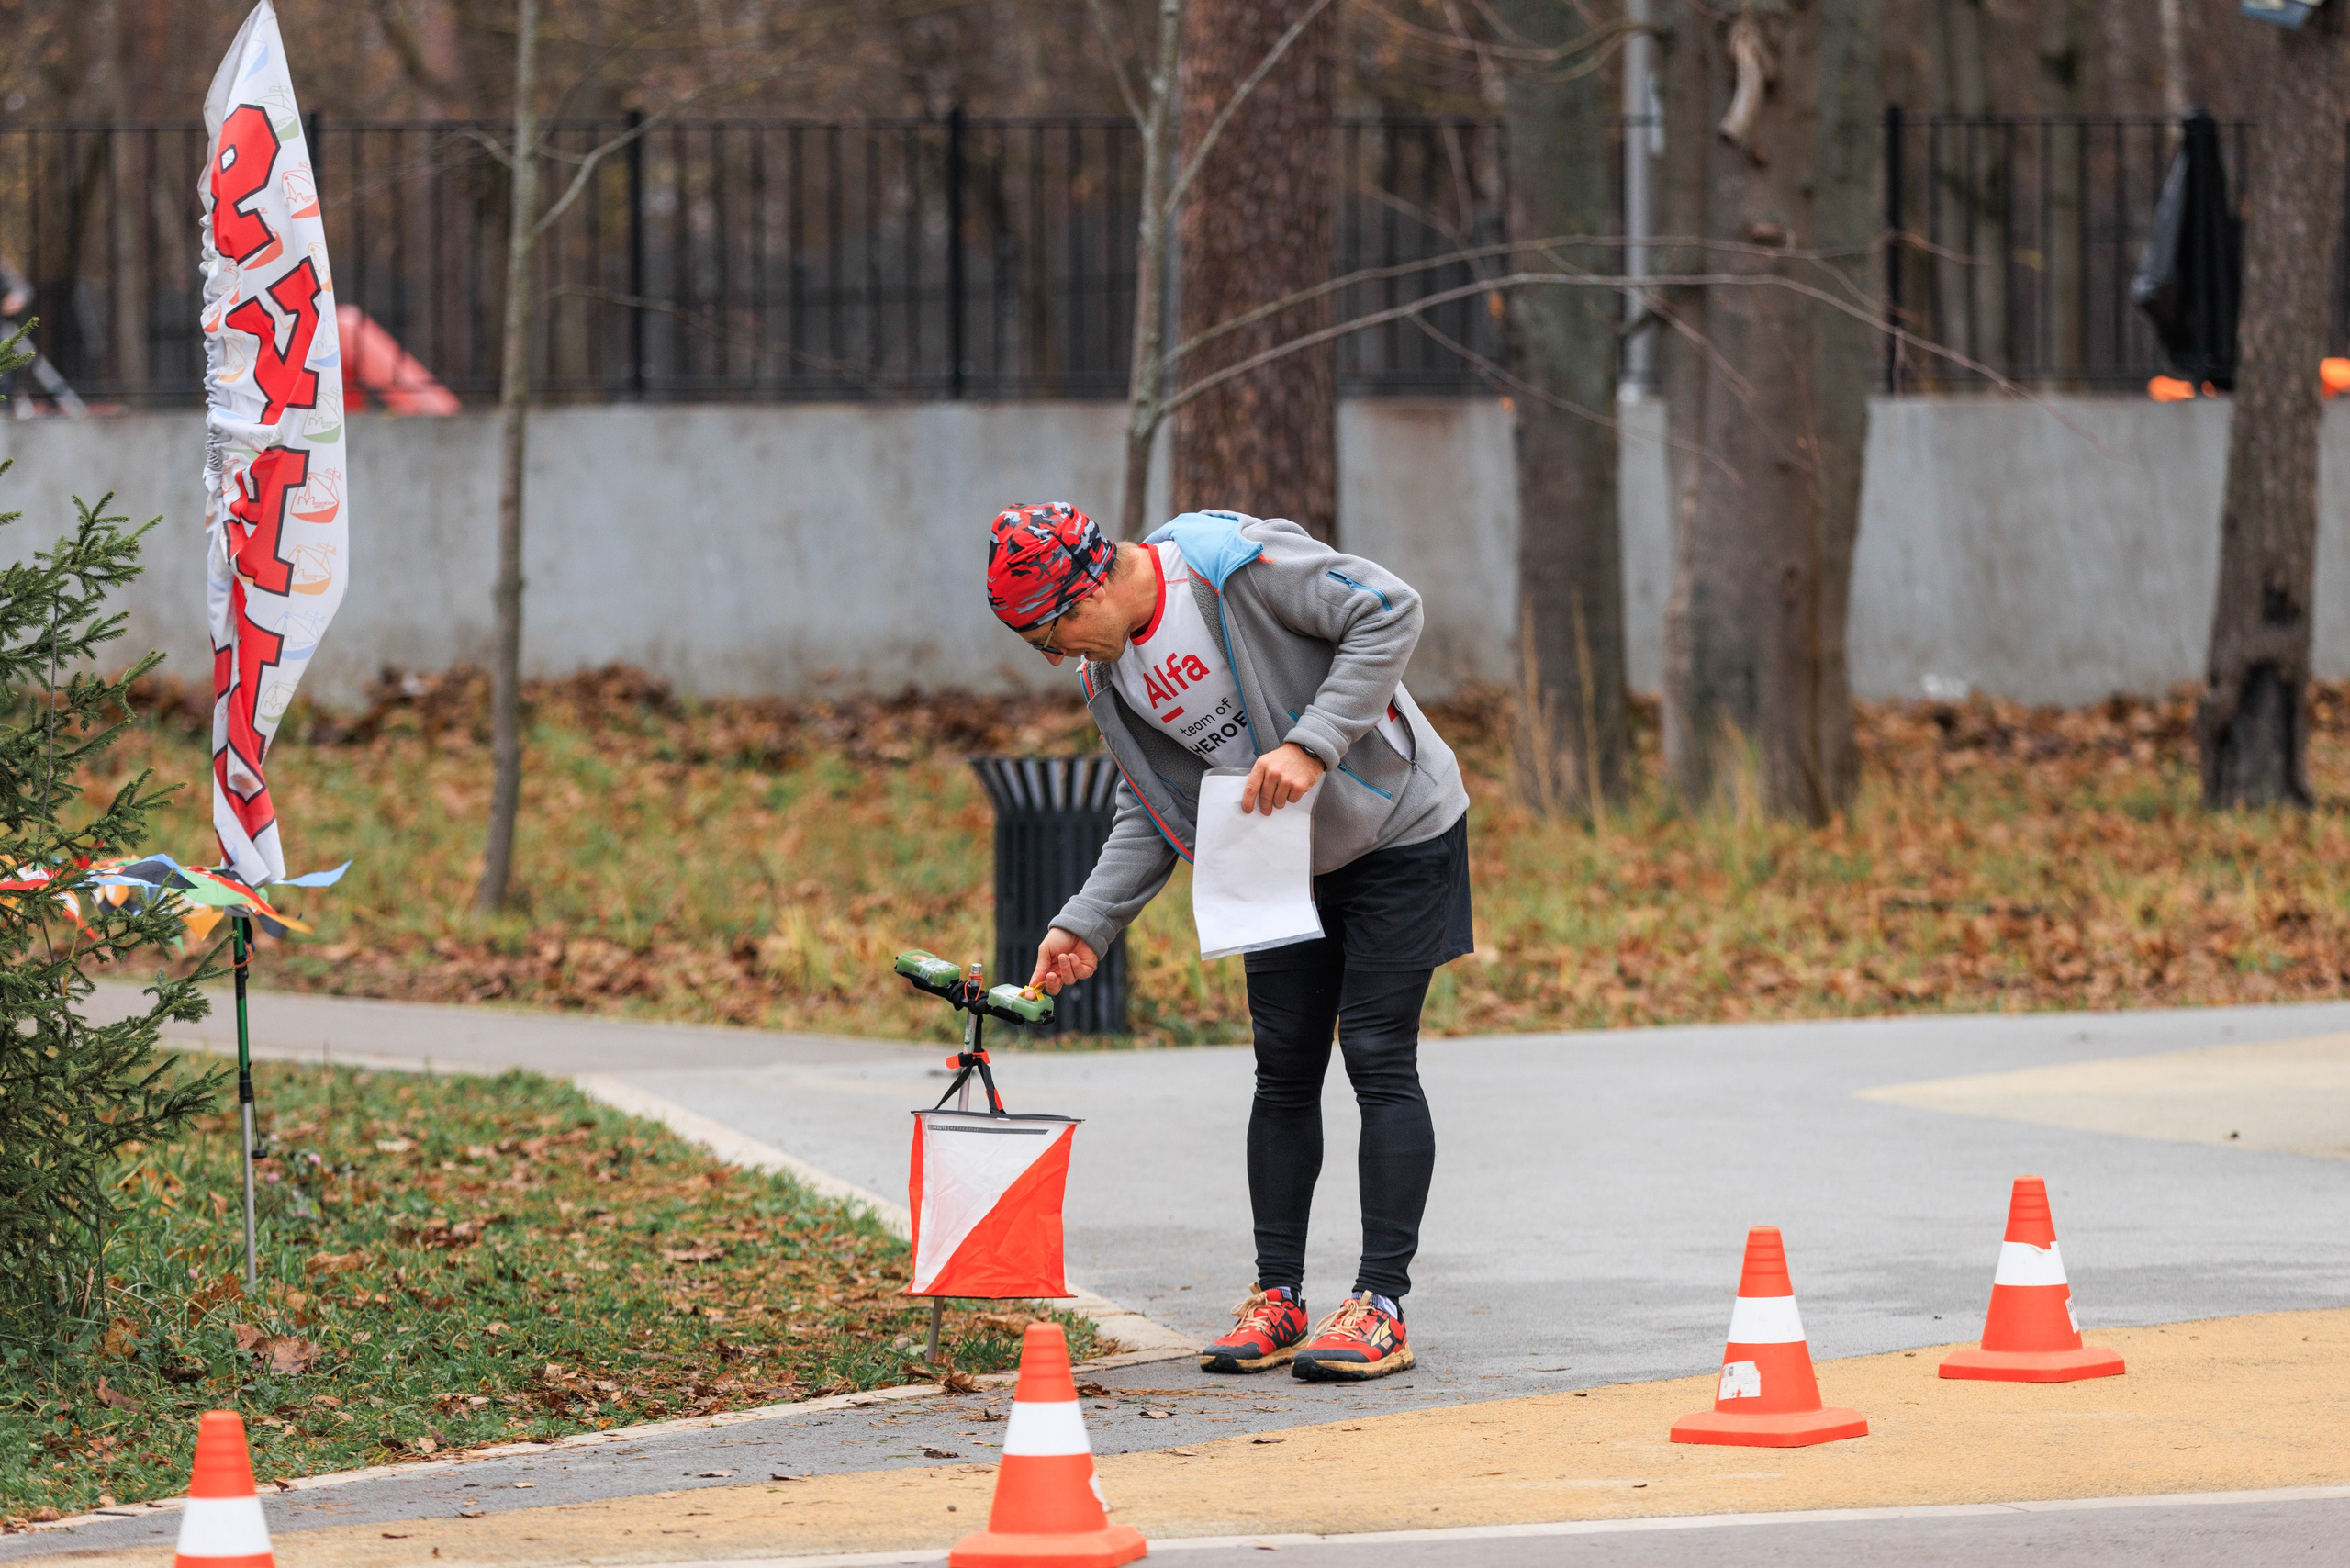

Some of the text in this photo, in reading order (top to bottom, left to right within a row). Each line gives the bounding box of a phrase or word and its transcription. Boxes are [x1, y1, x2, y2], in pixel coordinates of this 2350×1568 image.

[1143, 652, 1211, 710] Alfa
[1180, 697, 1232, 737] team of
